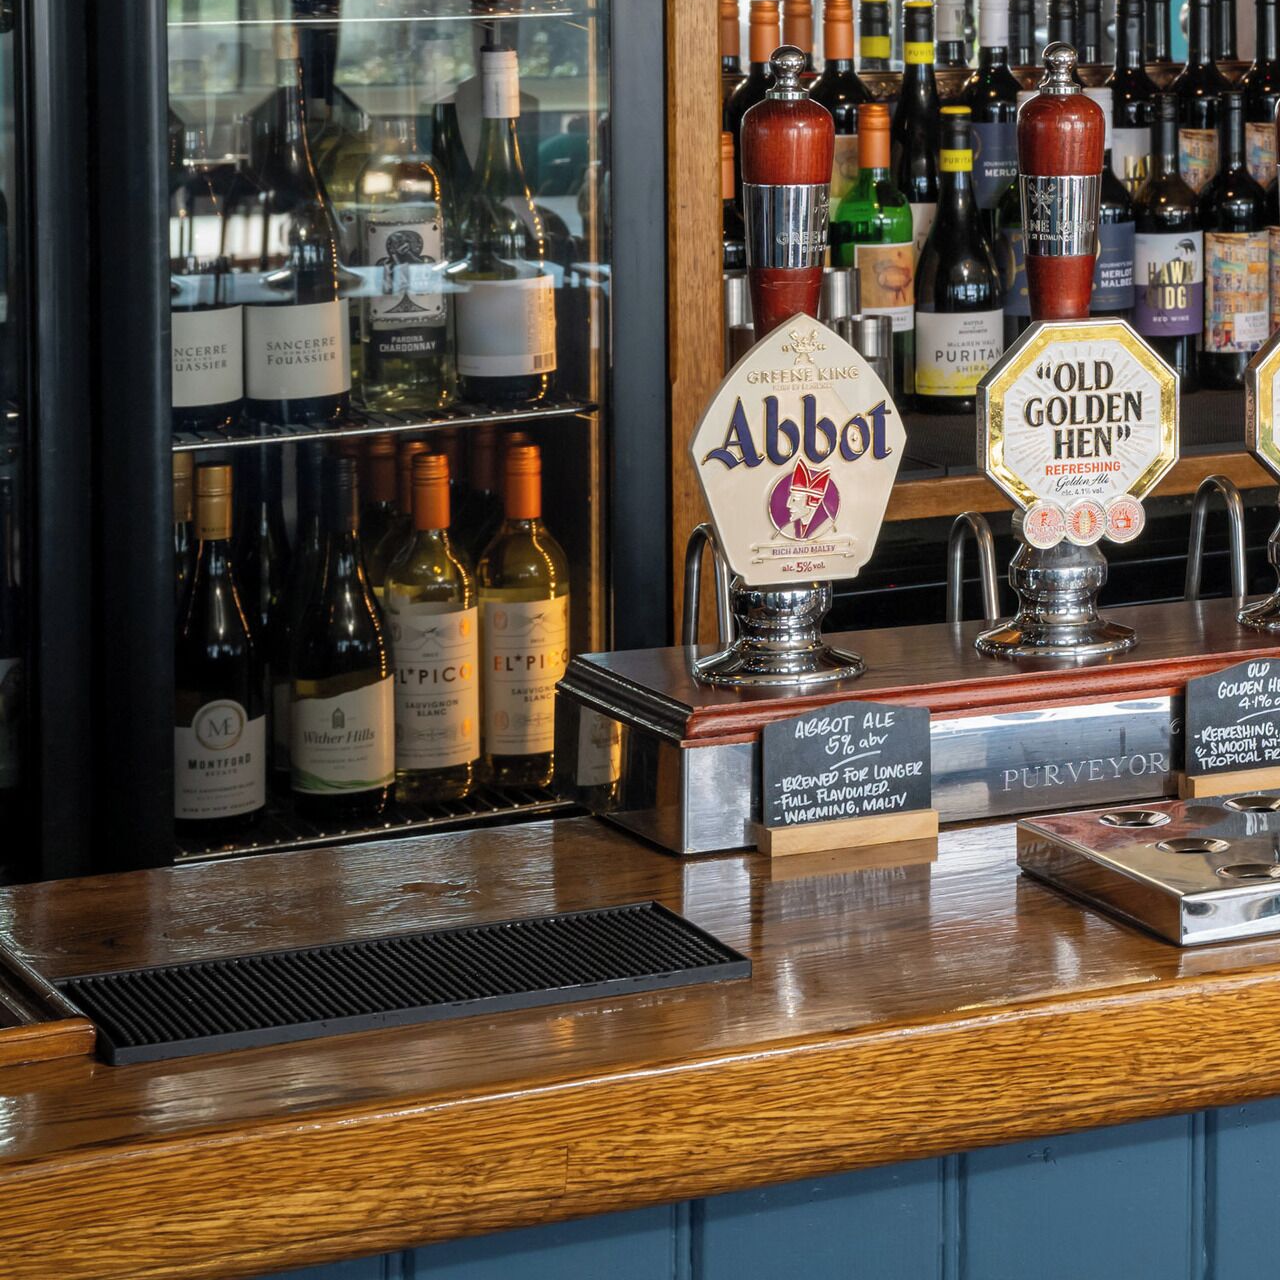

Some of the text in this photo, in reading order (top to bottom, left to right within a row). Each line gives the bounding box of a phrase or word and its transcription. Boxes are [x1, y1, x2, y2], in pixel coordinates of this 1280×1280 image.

[984, 168, 1017, 178] MERLO
[1152, 314, 1190, 323] RED WINE
[266, 336, 337, 352] SANCERRE
[379, 341, 436, 353] CHARDONNAY
[817, 365, 861, 382] KING
[1023, 390, 1143, 428] GOLDEN
[701, 393, 893, 470] Abbot
[1045, 461, 1121, 476] REFRESHING
[1055, 474, 1109, 492] Golden Ale
[772, 544, 836, 556] RICH AND MALTY
[782, 561, 826, 573] alc. 5% vol.
[1247, 662, 1271, 678] OLD
[1217, 679, 1264, 699] GOLDEN
[404, 698, 459, 710] SAUVIGNON
[417, 708, 448, 718] BLANC
[794, 711, 895, 739] ABBOT ALE
[303, 728, 376, 745] Wither Hills
[825, 732, 889, 755] 5% abv
[1210, 737, 1258, 756] SMOOTH
[188, 753, 252, 770] MONTFORD
[1199, 750, 1262, 770] TROPICAL
[842, 766, 869, 784] FOR
[874, 760, 923, 780] LONGER
[1002, 752, 1169, 792] PURVEYOR
[816, 780, 890, 804] FLAVOURED.
[862, 792, 907, 811] MALTY
